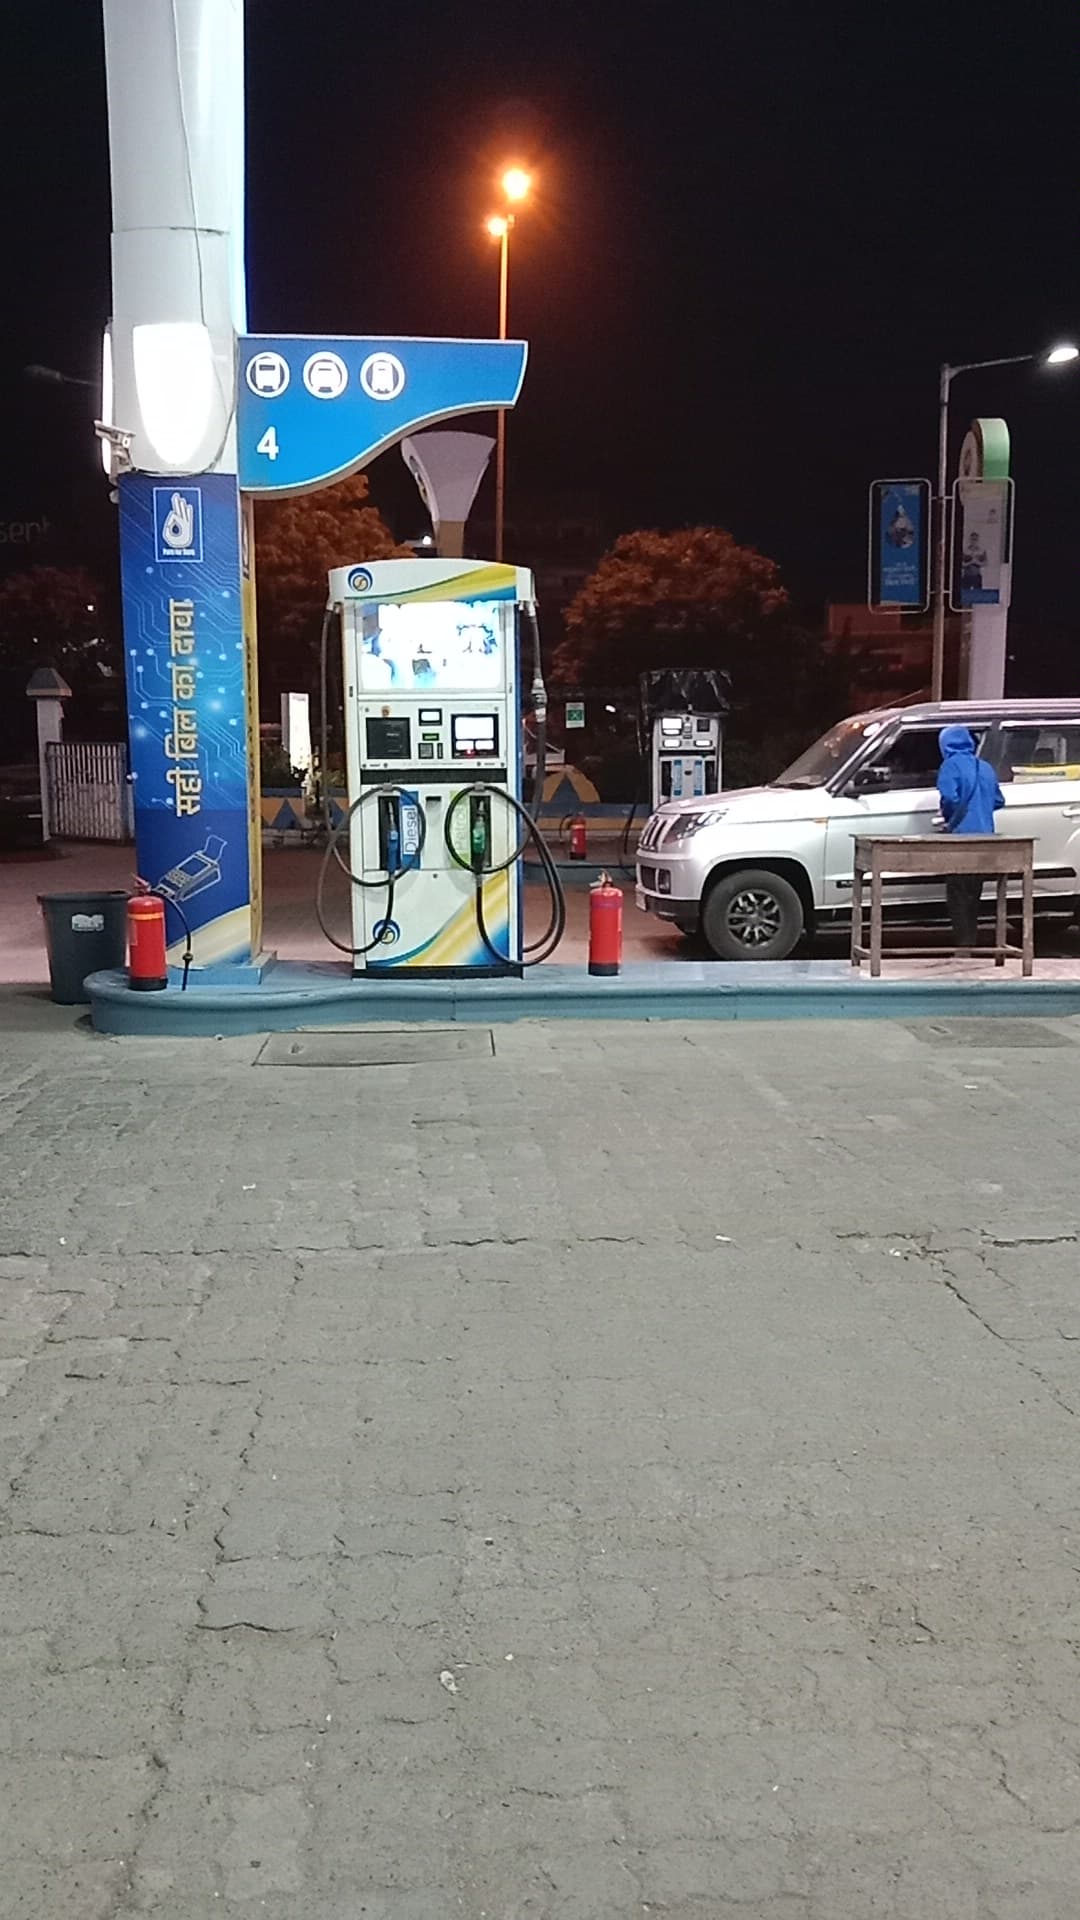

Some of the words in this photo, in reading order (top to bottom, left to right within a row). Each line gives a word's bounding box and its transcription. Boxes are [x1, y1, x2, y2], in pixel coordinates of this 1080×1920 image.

[256, 425, 280, 461] 4
[169, 598, 195, 657] दावा
[172, 662, 196, 701] का
[165, 707, 199, 761] बिल
[166, 766, 202, 817] सही
[404, 807, 418, 854] Diesel
